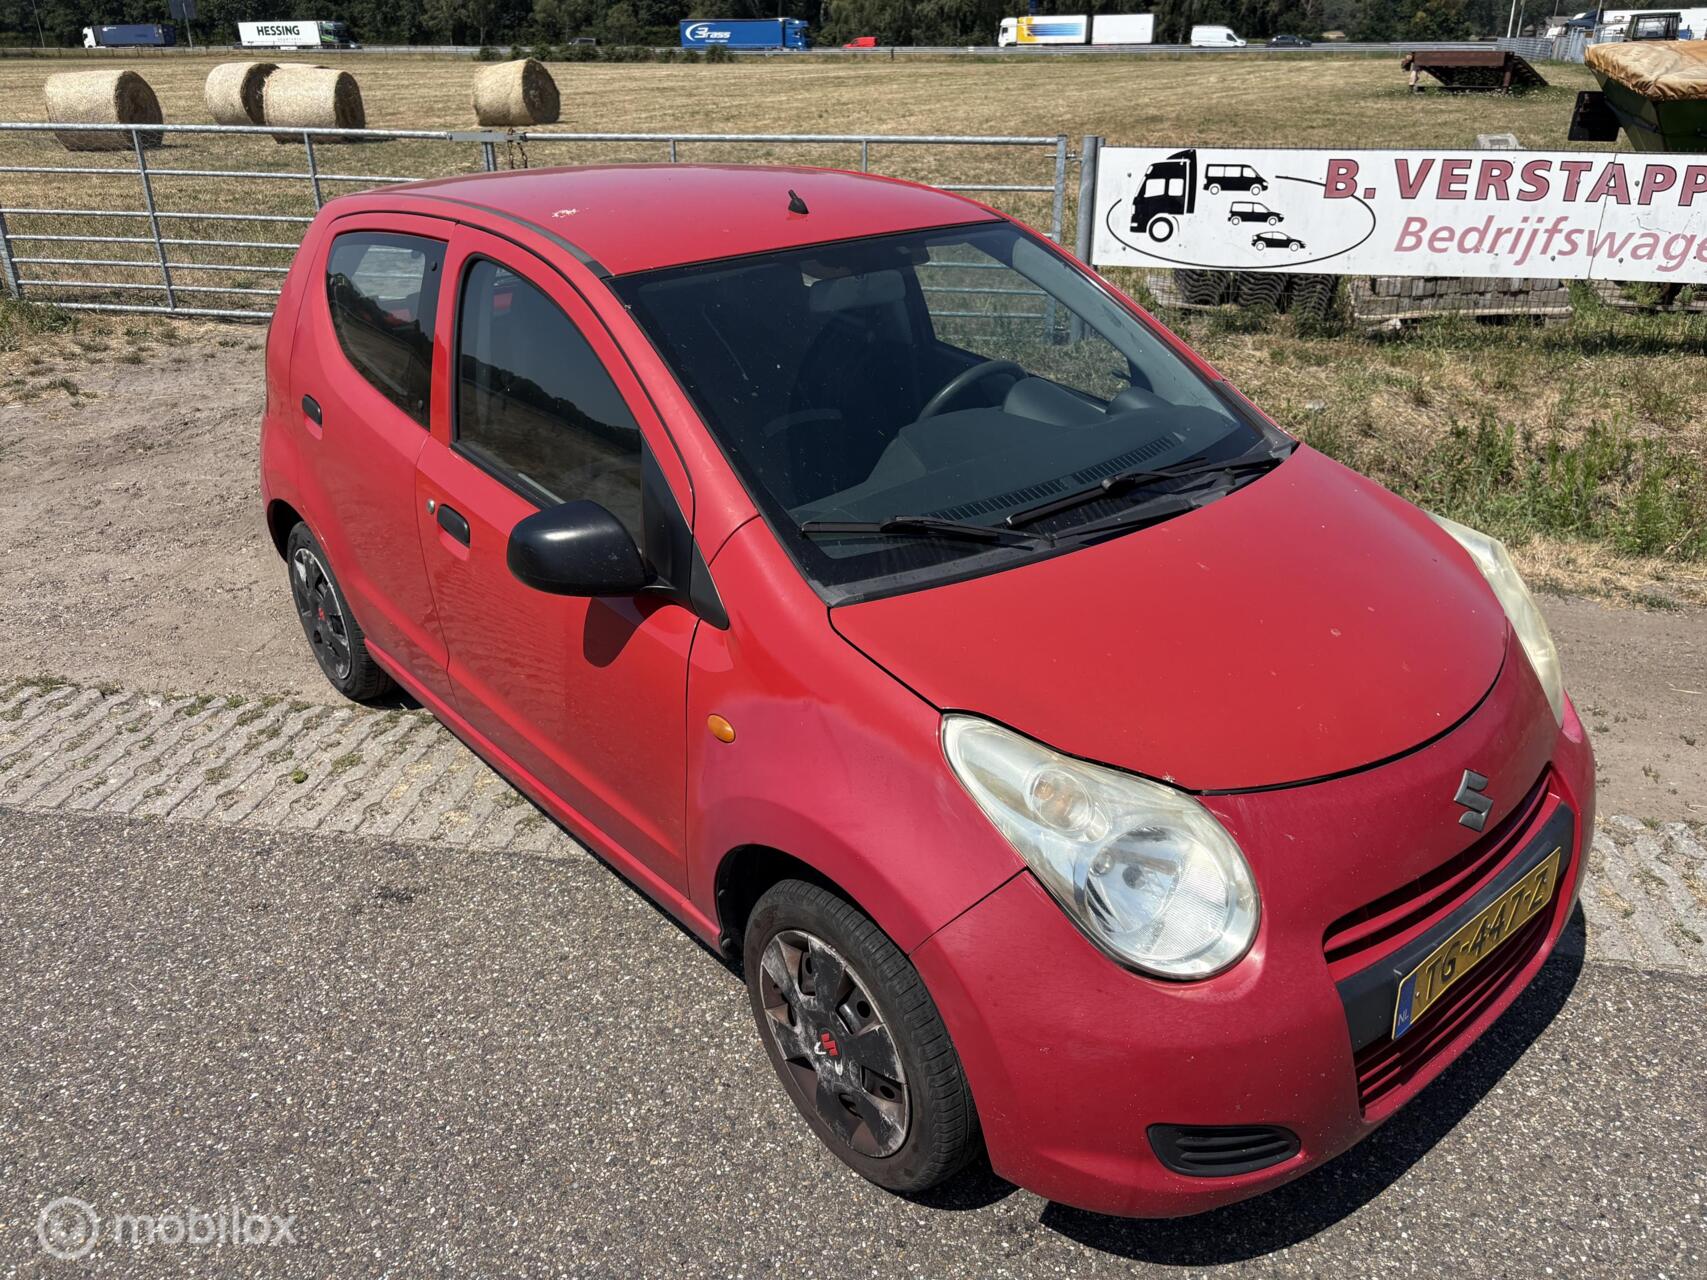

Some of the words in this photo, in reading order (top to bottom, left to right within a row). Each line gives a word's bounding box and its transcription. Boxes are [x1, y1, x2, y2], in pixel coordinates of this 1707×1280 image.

[256, 25, 301, 36] HESSING
[1323, 158, 1377, 200] B.
[1394, 158, 1707, 207] VERSTAPP
[1424, 864, 1549, 1001] TG-447-Z
